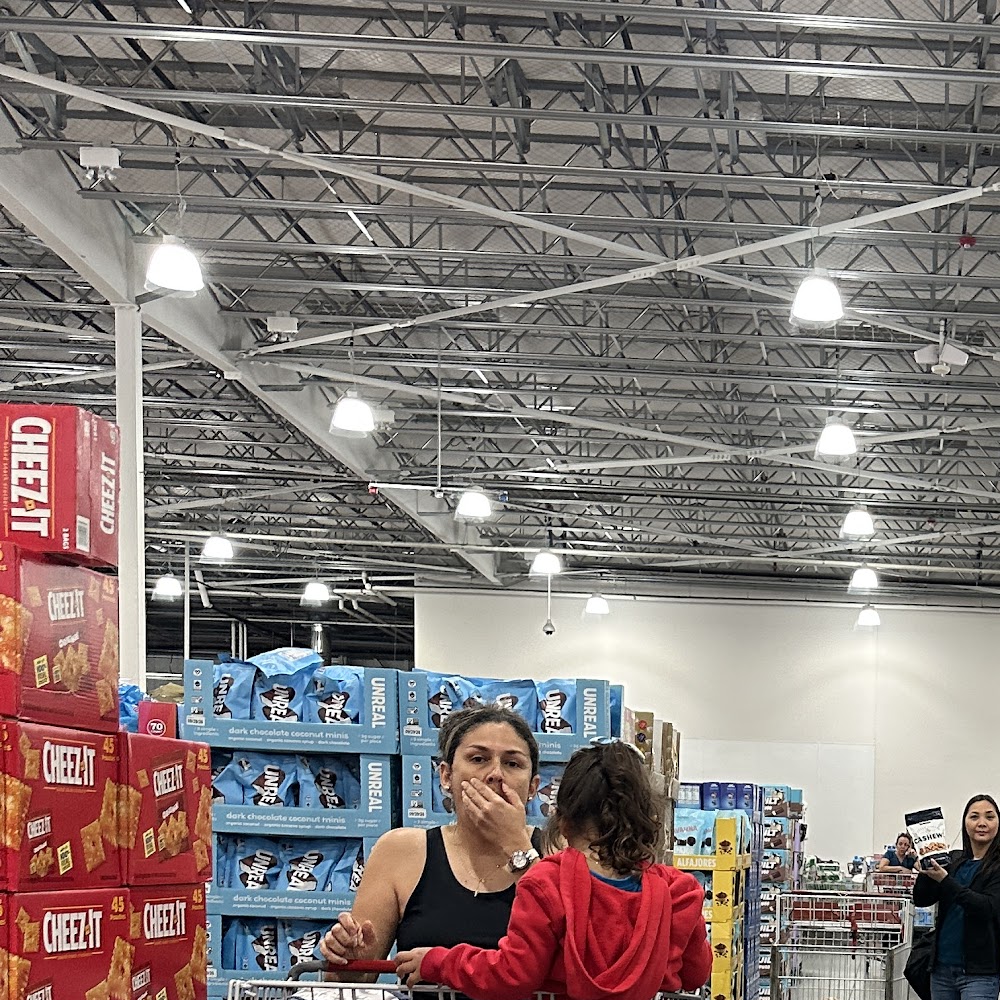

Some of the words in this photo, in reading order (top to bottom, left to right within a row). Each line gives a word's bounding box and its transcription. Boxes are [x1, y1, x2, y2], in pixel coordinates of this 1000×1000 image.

[62, 534, 70, 550] BAGS
[213, 673, 232, 713] UNRE
[270, 683, 290, 721] UNREA
[371, 678, 386, 729] UNREAL
[545, 689, 563, 733] UNREA
[583, 687, 597, 738] UNREAL
[150, 723, 163, 731] 70
[229, 727, 248, 735] dark
[249, 728, 289, 737] chocolate
[291, 731, 324, 739] coconut
[325, 731, 349, 739] minis
[103, 738, 115, 754] 45
[197, 748, 209, 763] 45
[260, 765, 280, 806] UNREA
[368, 762, 383, 812] UNREAL
[226, 811, 246, 819] dark
[247, 813, 287, 821] chocolate
[245, 850, 274, 889] UNREA
[287, 850, 319, 891] UNREA
[677, 858, 717, 867] ALFAJORES
[111, 896, 125, 913] 45
[192, 889, 203, 903] 45
[233, 894, 253, 902] dark
[254, 895, 293, 904] chocolate
[293, 897, 326, 905] coconut
[328, 898, 351, 906] minis
[261, 926, 279, 971] UNREA
